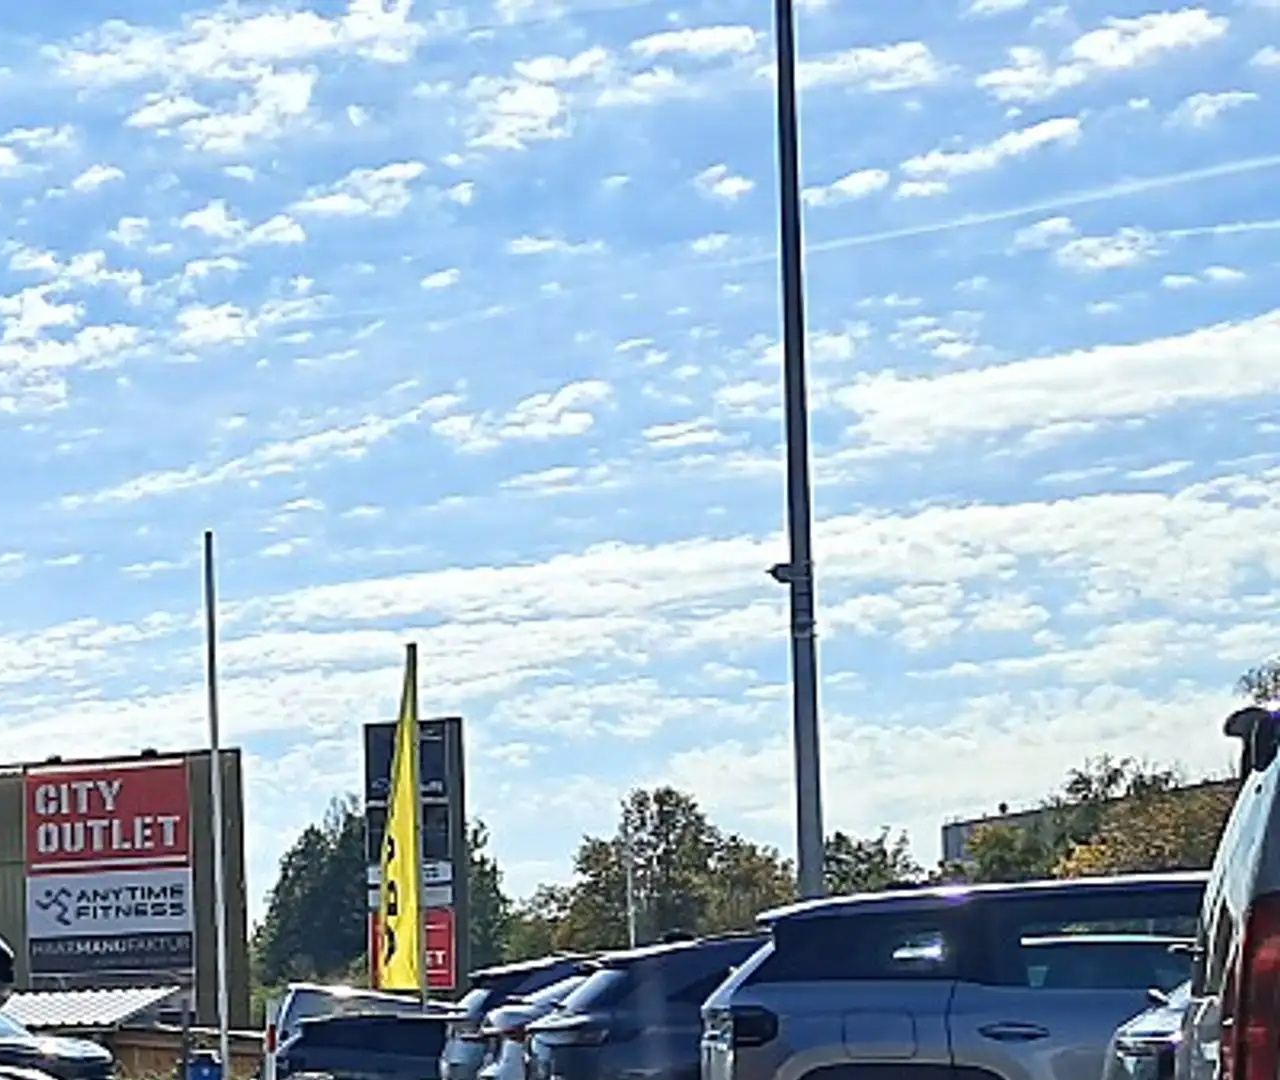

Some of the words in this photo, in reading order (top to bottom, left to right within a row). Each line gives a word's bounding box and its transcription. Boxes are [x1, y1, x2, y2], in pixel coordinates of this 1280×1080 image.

[34, 778, 123, 815] CITY
[36, 815, 181, 853] OUTLET
[75, 884, 186, 902] ANYTIME
[75, 902, 187, 920] FITNESS
